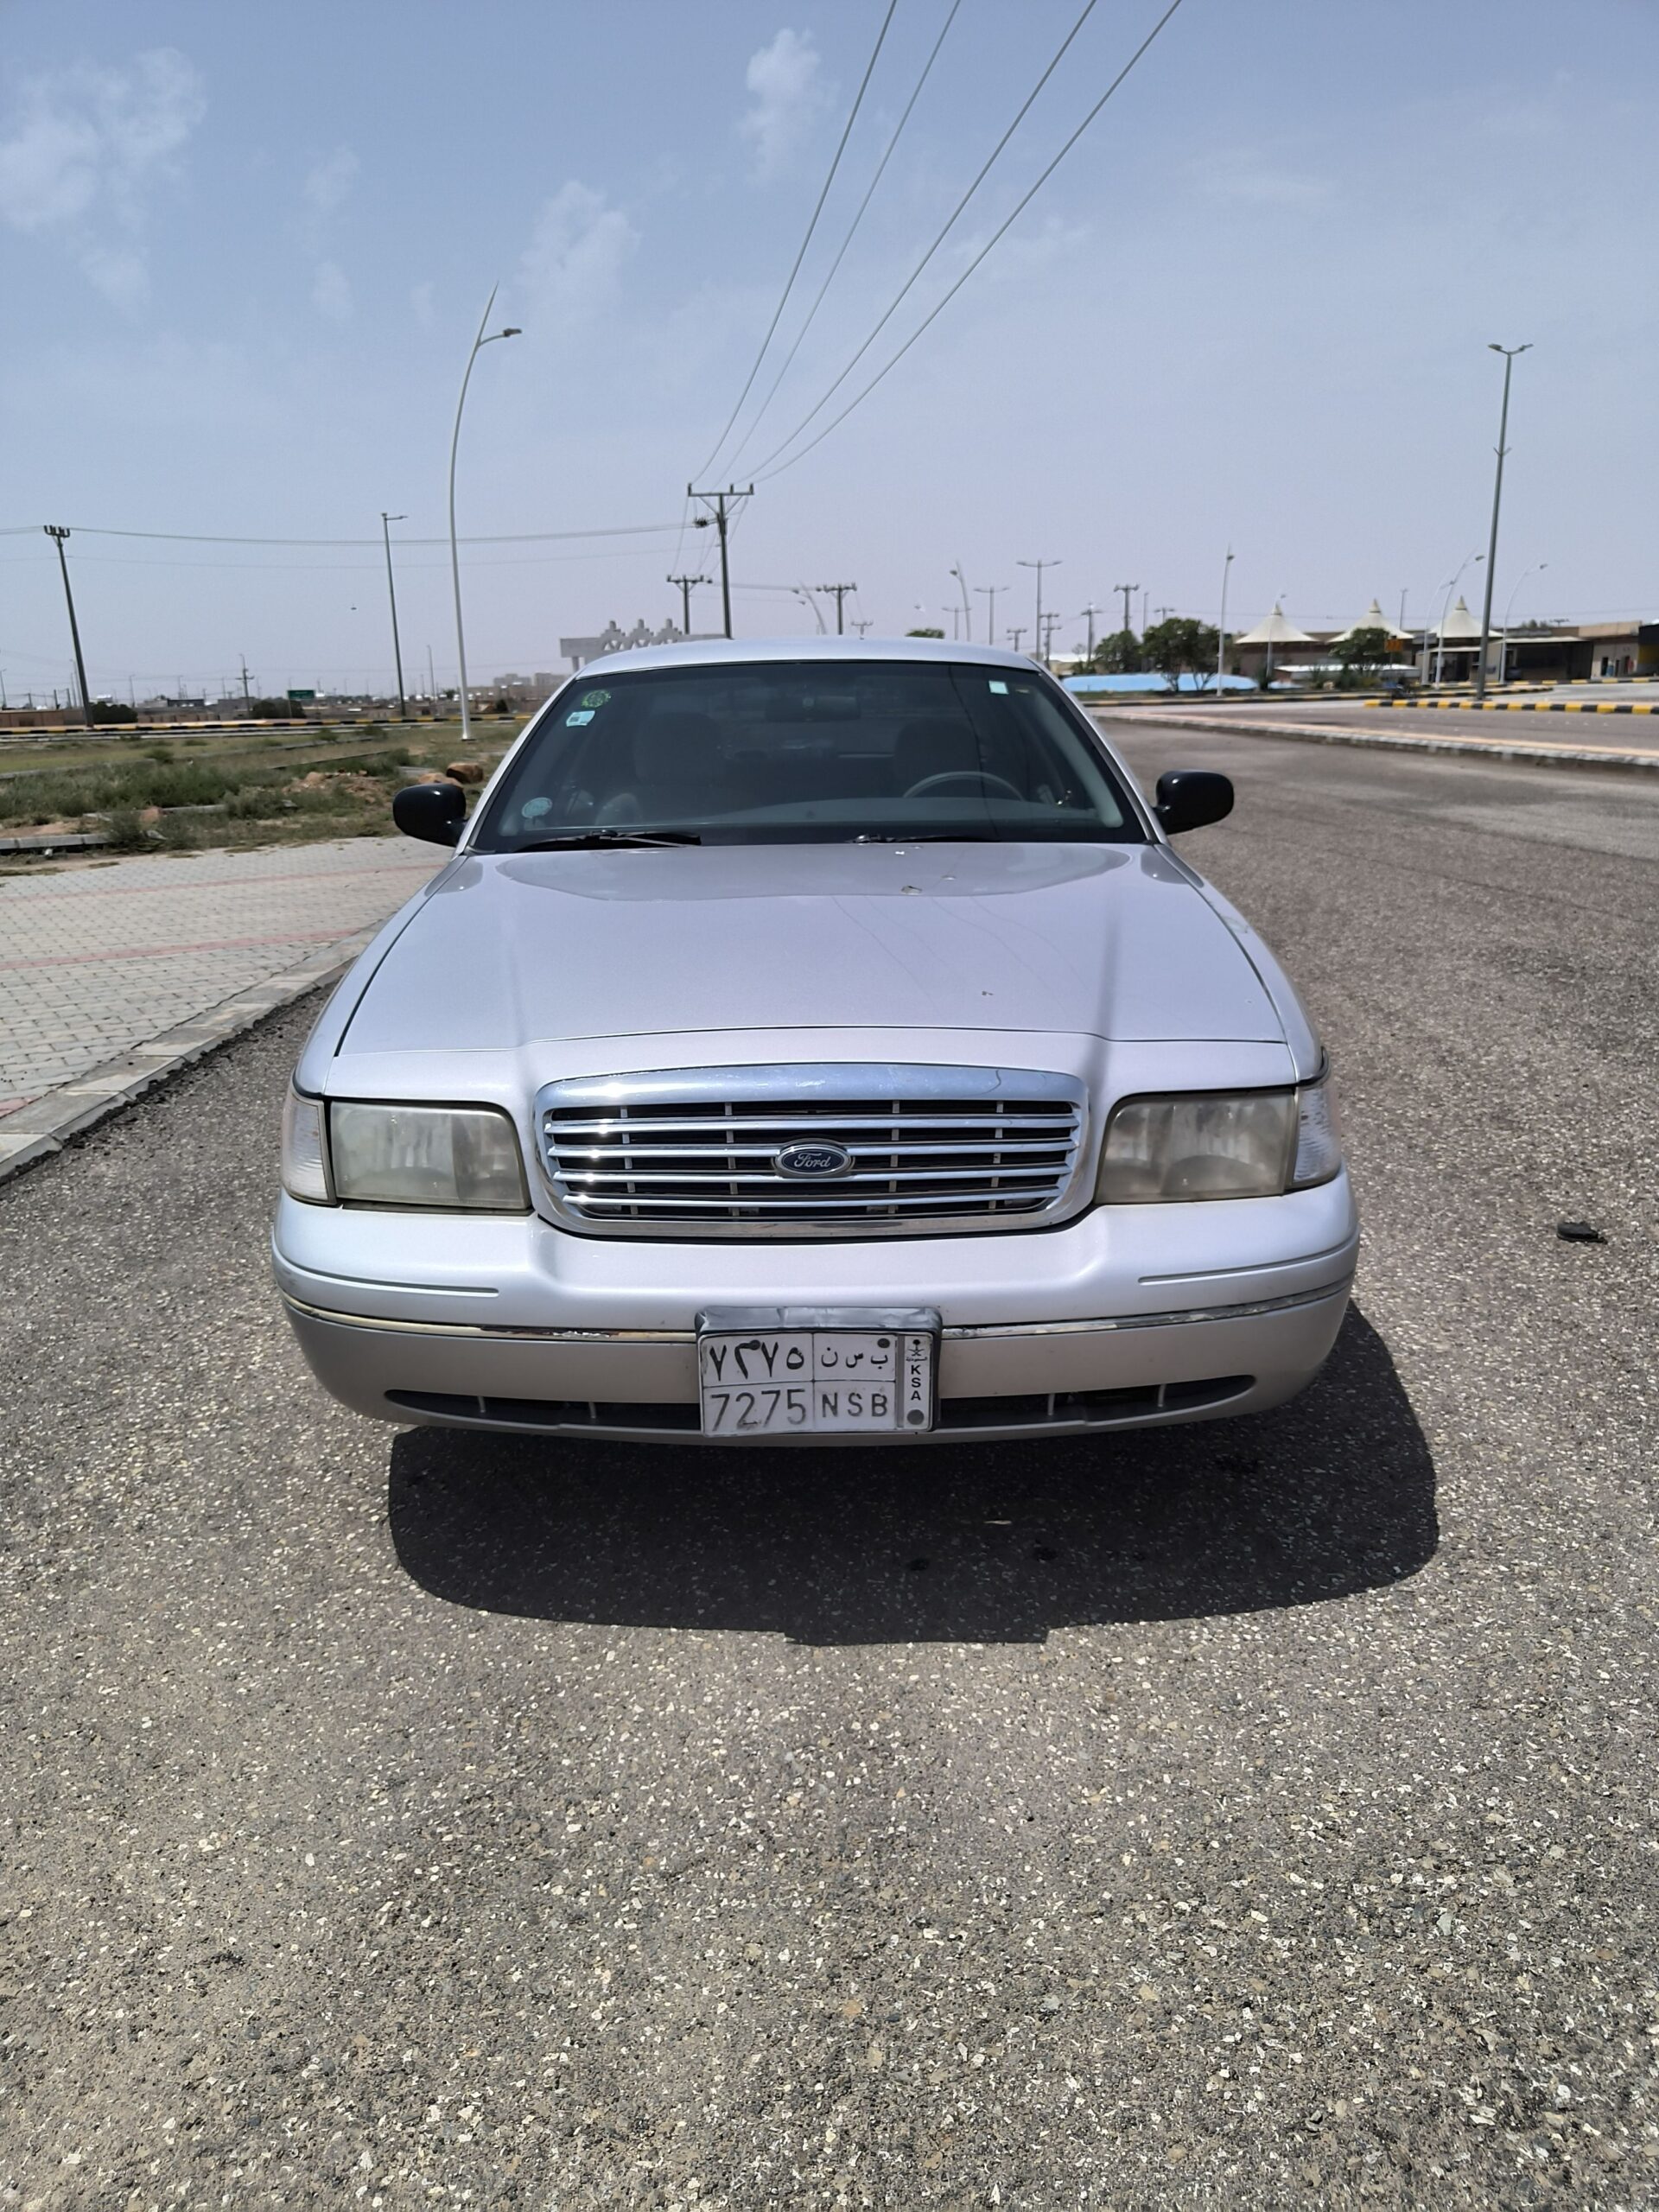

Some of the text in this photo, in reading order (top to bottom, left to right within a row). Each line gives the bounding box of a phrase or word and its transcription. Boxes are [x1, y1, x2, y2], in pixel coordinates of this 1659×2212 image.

[794, 1152, 831, 1167] Ford
[709, 1339, 804, 1381] ٧٢٧٥
[911, 1364, 921, 1401] KSA
[711, 1389, 806, 1431] 7275
[822, 1392, 887, 1417] NSB
